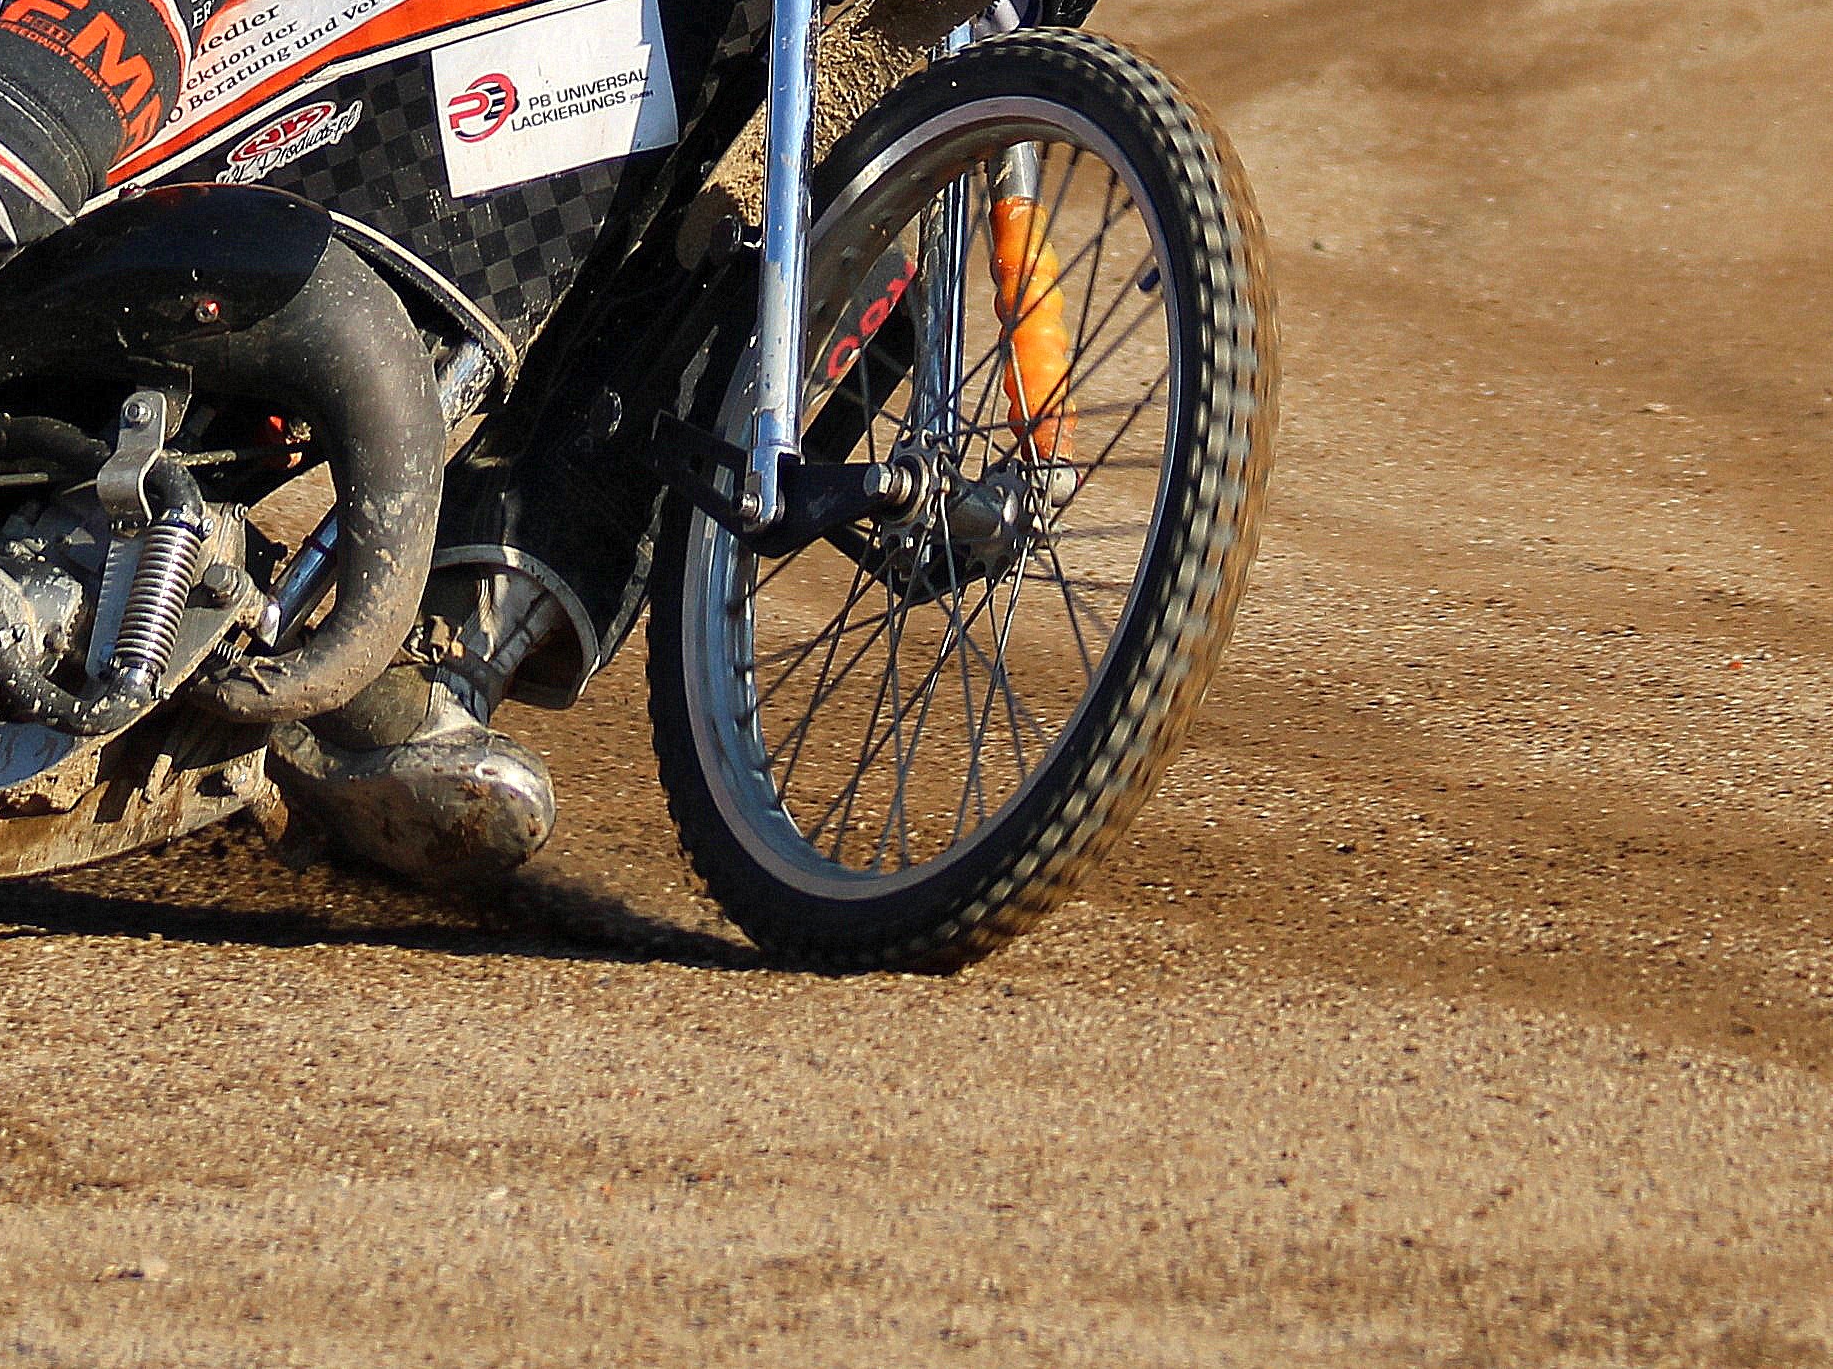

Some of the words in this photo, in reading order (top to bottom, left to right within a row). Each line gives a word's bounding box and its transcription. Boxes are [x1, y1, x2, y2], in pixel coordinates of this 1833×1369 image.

[199, 3, 280, 57] iedler
[182, 46, 257, 95] ektion
[260, 20, 302, 48] der
[187, 45, 292, 112] Beratung
[293, 17, 339, 50] und
[511, 91, 626, 132] LACKIERUNGS
[528, 93, 551, 111] PB
[556, 68, 649, 104] UNIVERSAL
